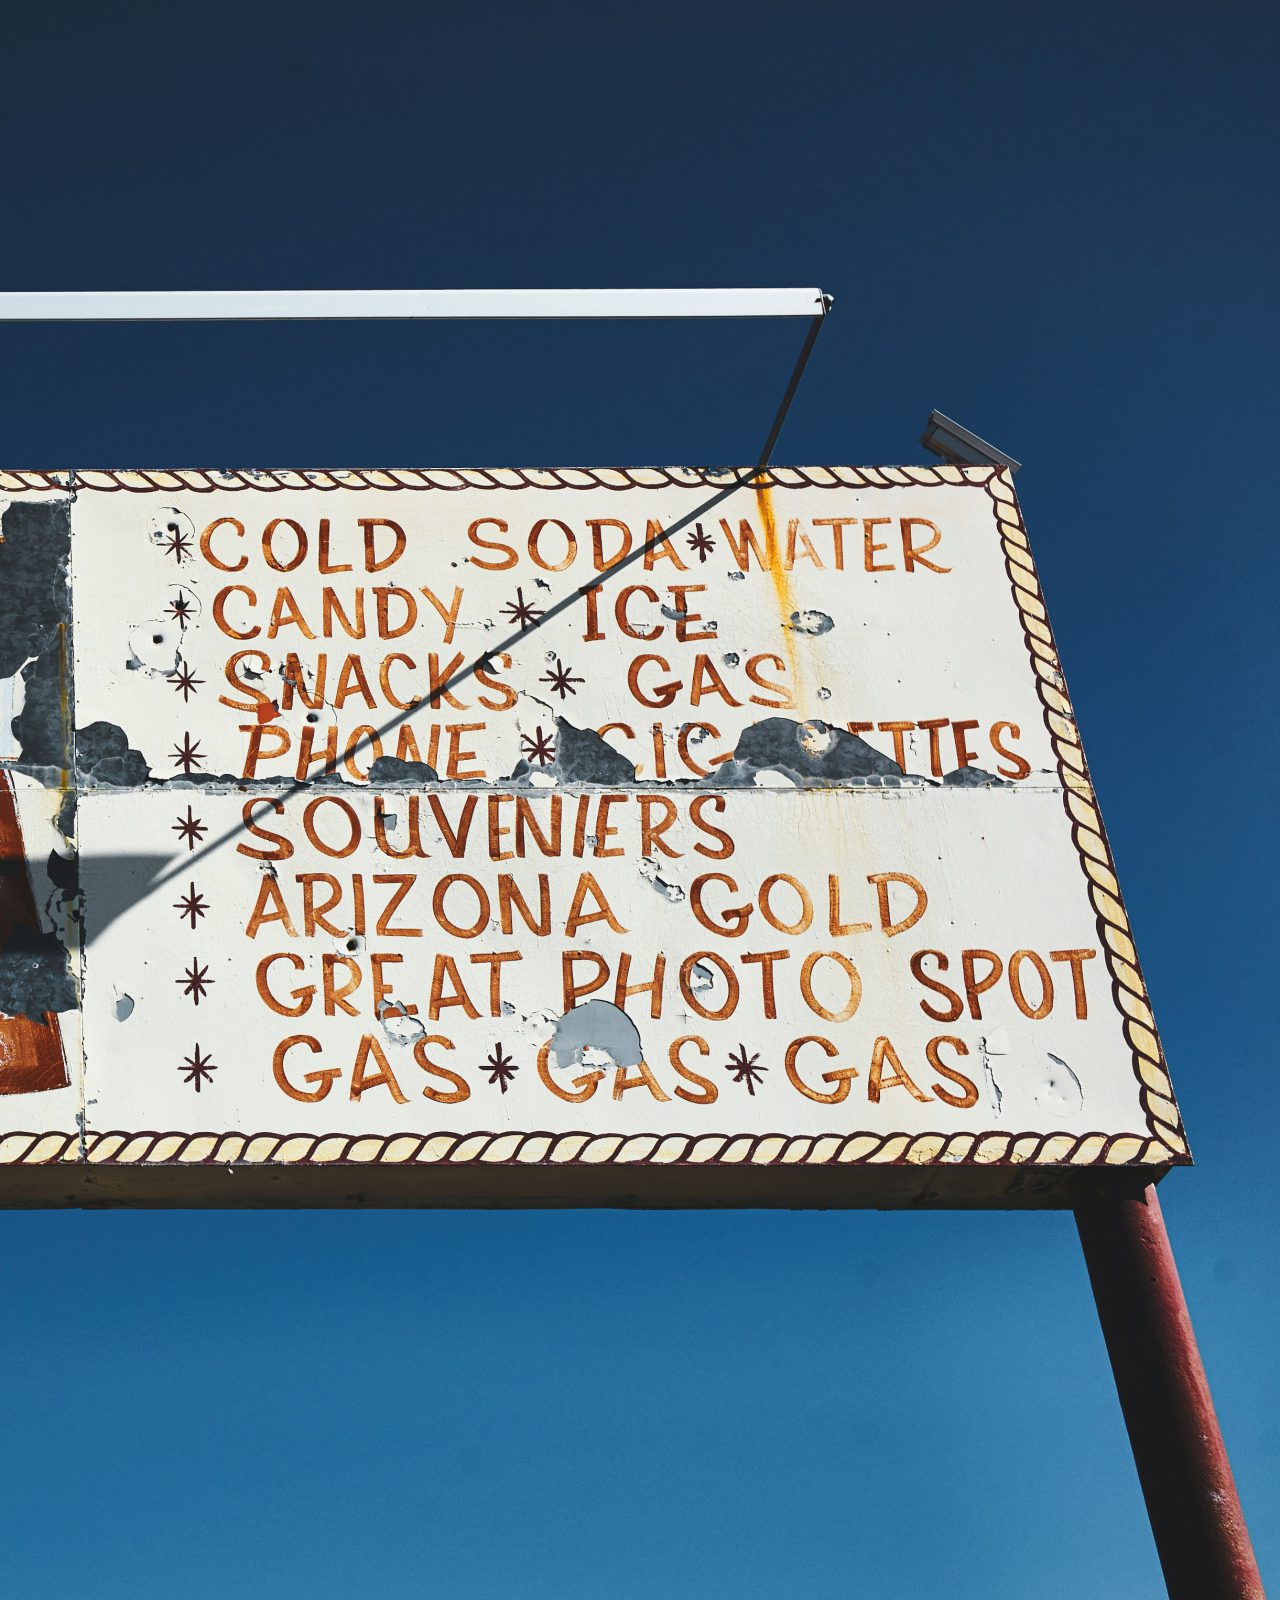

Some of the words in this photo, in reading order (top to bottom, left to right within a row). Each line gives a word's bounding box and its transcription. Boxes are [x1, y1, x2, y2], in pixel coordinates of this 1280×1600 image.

[199, 517, 408, 574] COLD
[467, 515, 690, 573] SODA
[719, 516, 952, 574] WATER
[212, 584, 465, 645] CANDY
[581, 584, 718, 642] ICE
[218, 649, 518, 712] SNACKS
[627, 652, 798, 710] GAS
[238, 722, 487, 783] PHONE
[236, 793, 736, 862] SOUVENIERS
[245, 870, 631, 939] ARIZONA
[689, 871, 929, 938] GOLD
[255, 950, 523, 1021] GREAT
[562, 949, 863, 1024] PHOTO
[909, 948, 1097, 1023] SPOT
[272, 1034, 471, 1104] GAS
[537, 1034, 720, 1105] GAS
[784, 1034, 980, 1109] GAS
